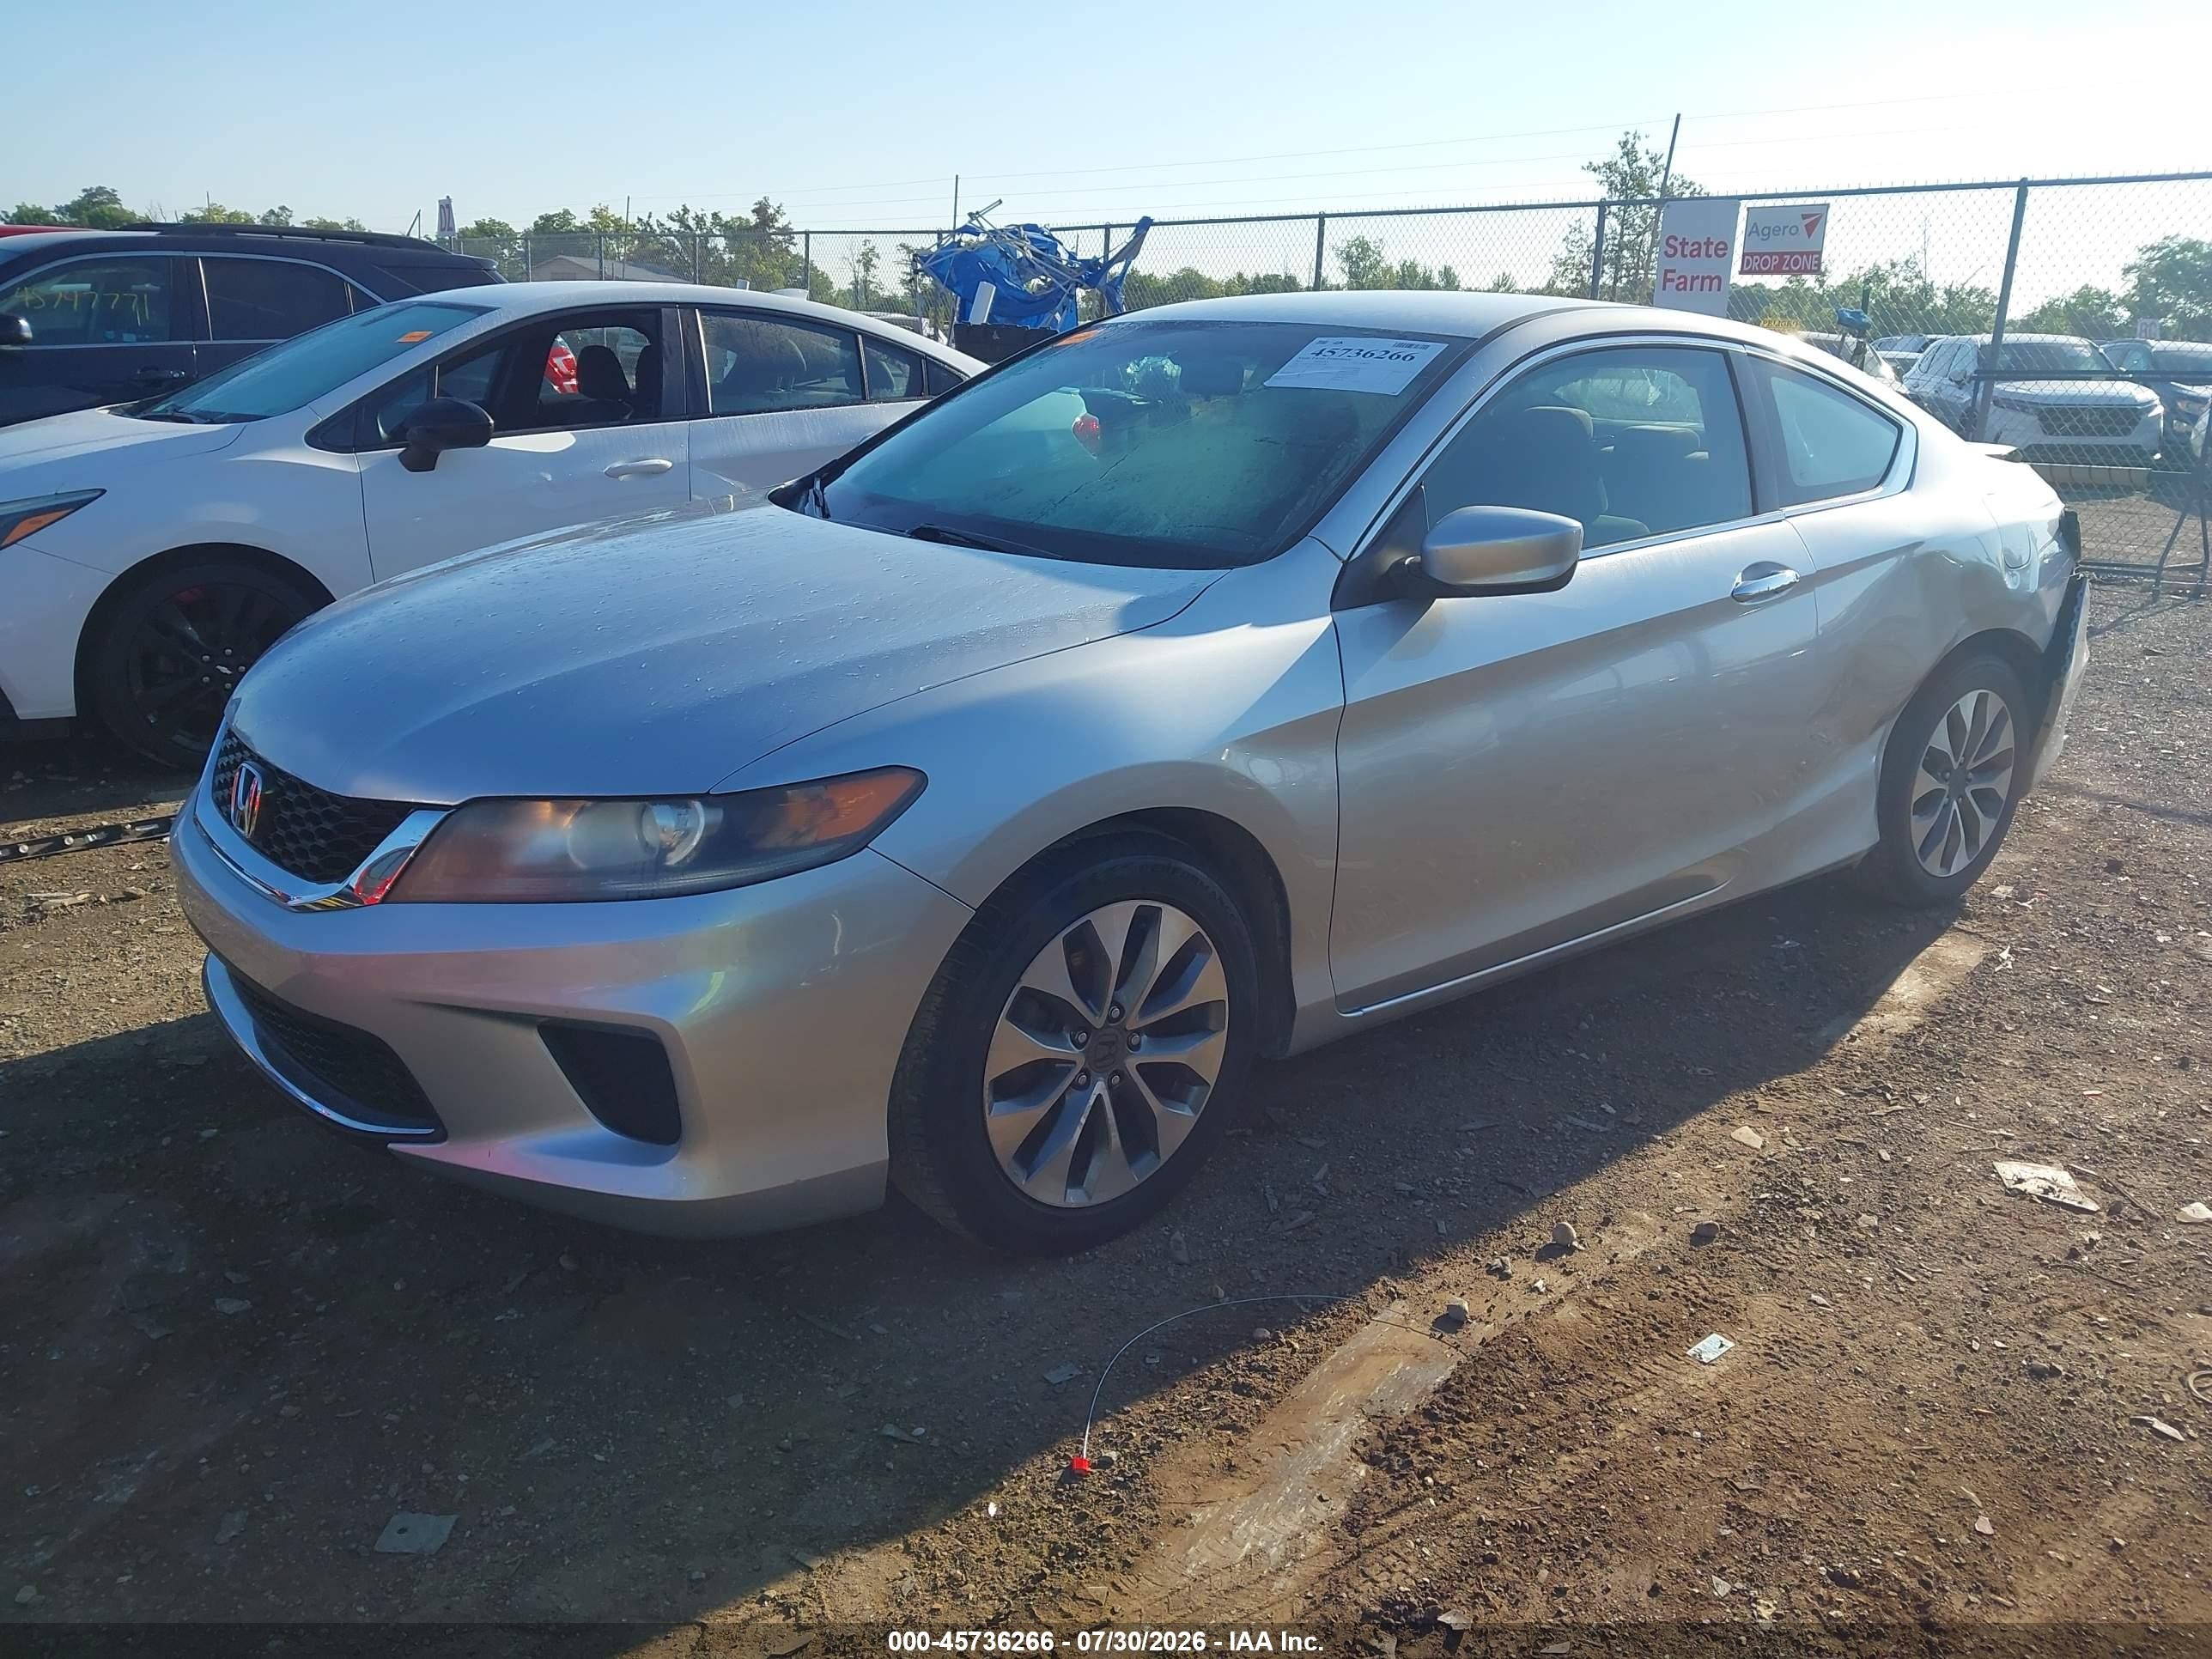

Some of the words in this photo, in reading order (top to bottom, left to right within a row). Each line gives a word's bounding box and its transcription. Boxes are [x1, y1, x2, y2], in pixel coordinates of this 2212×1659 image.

[1747, 222, 1800, 241] Agero
[1663, 234, 1729, 258] State
[1742, 254, 1779, 271] DROP
[1782, 254, 1820, 270] ZONE
[1662, 268, 1723, 292] Farm
[1310, 347, 1418, 362] 45736266
